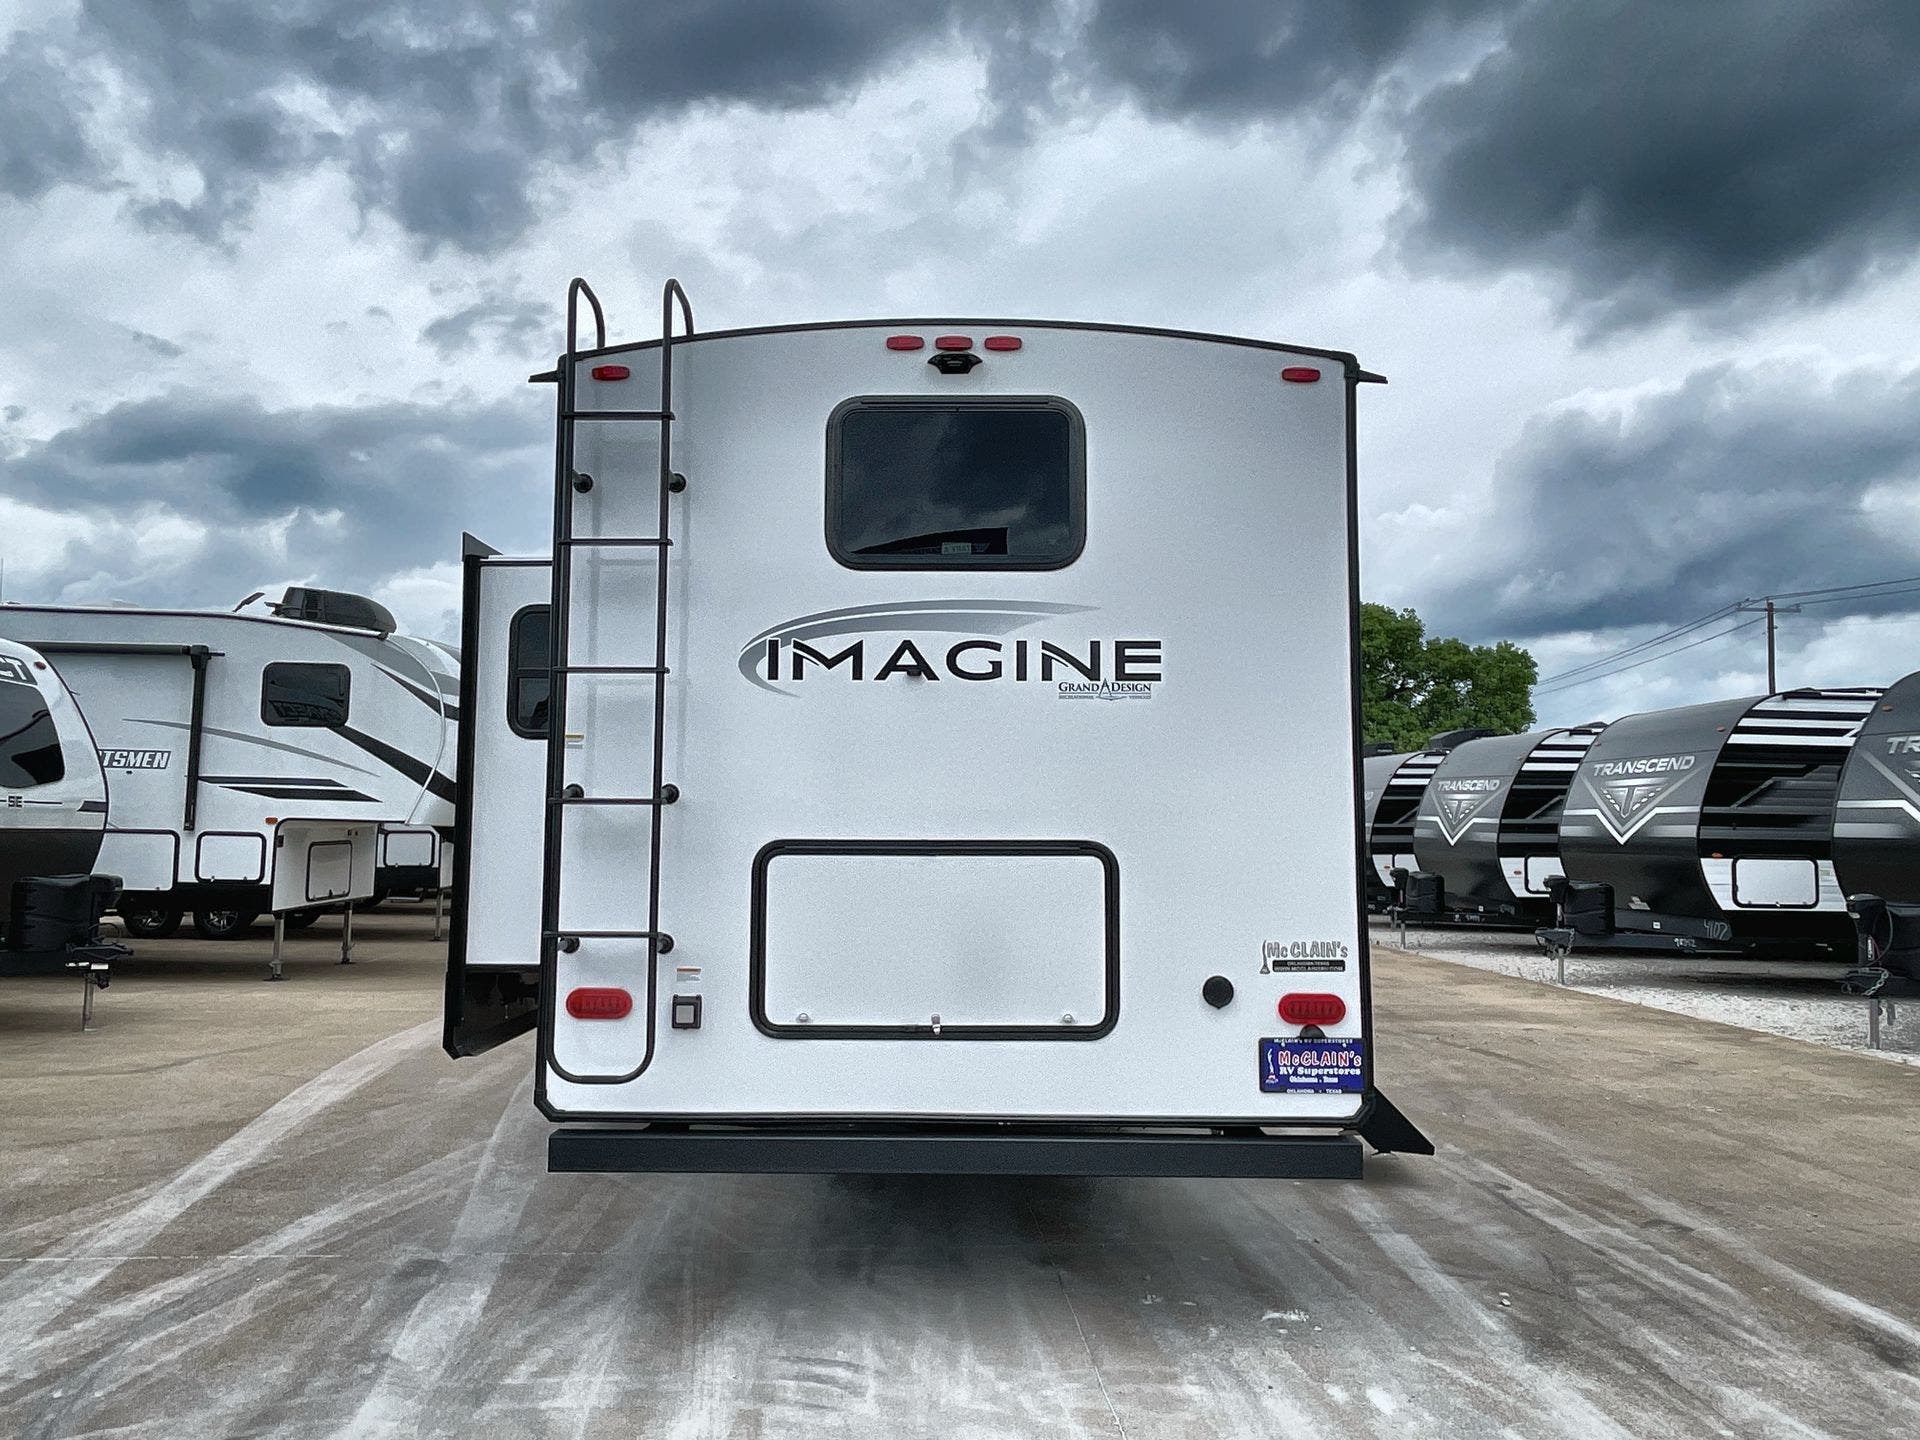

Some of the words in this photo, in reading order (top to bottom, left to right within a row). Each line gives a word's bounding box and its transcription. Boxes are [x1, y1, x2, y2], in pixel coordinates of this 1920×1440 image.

[767, 639, 1162, 682] IMAGINE
[1058, 681, 1100, 692] GRAND
[1111, 681, 1152, 692] DESIGN
[99, 750, 169, 768] TSMEN
[1593, 755, 1696, 776] TRANSCEND
[1437, 780, 1500, 791] TRANSCEND
[1279, 1066, 1295, 1075] RV
[1297, 1066, 1361, 1077] Superstores
